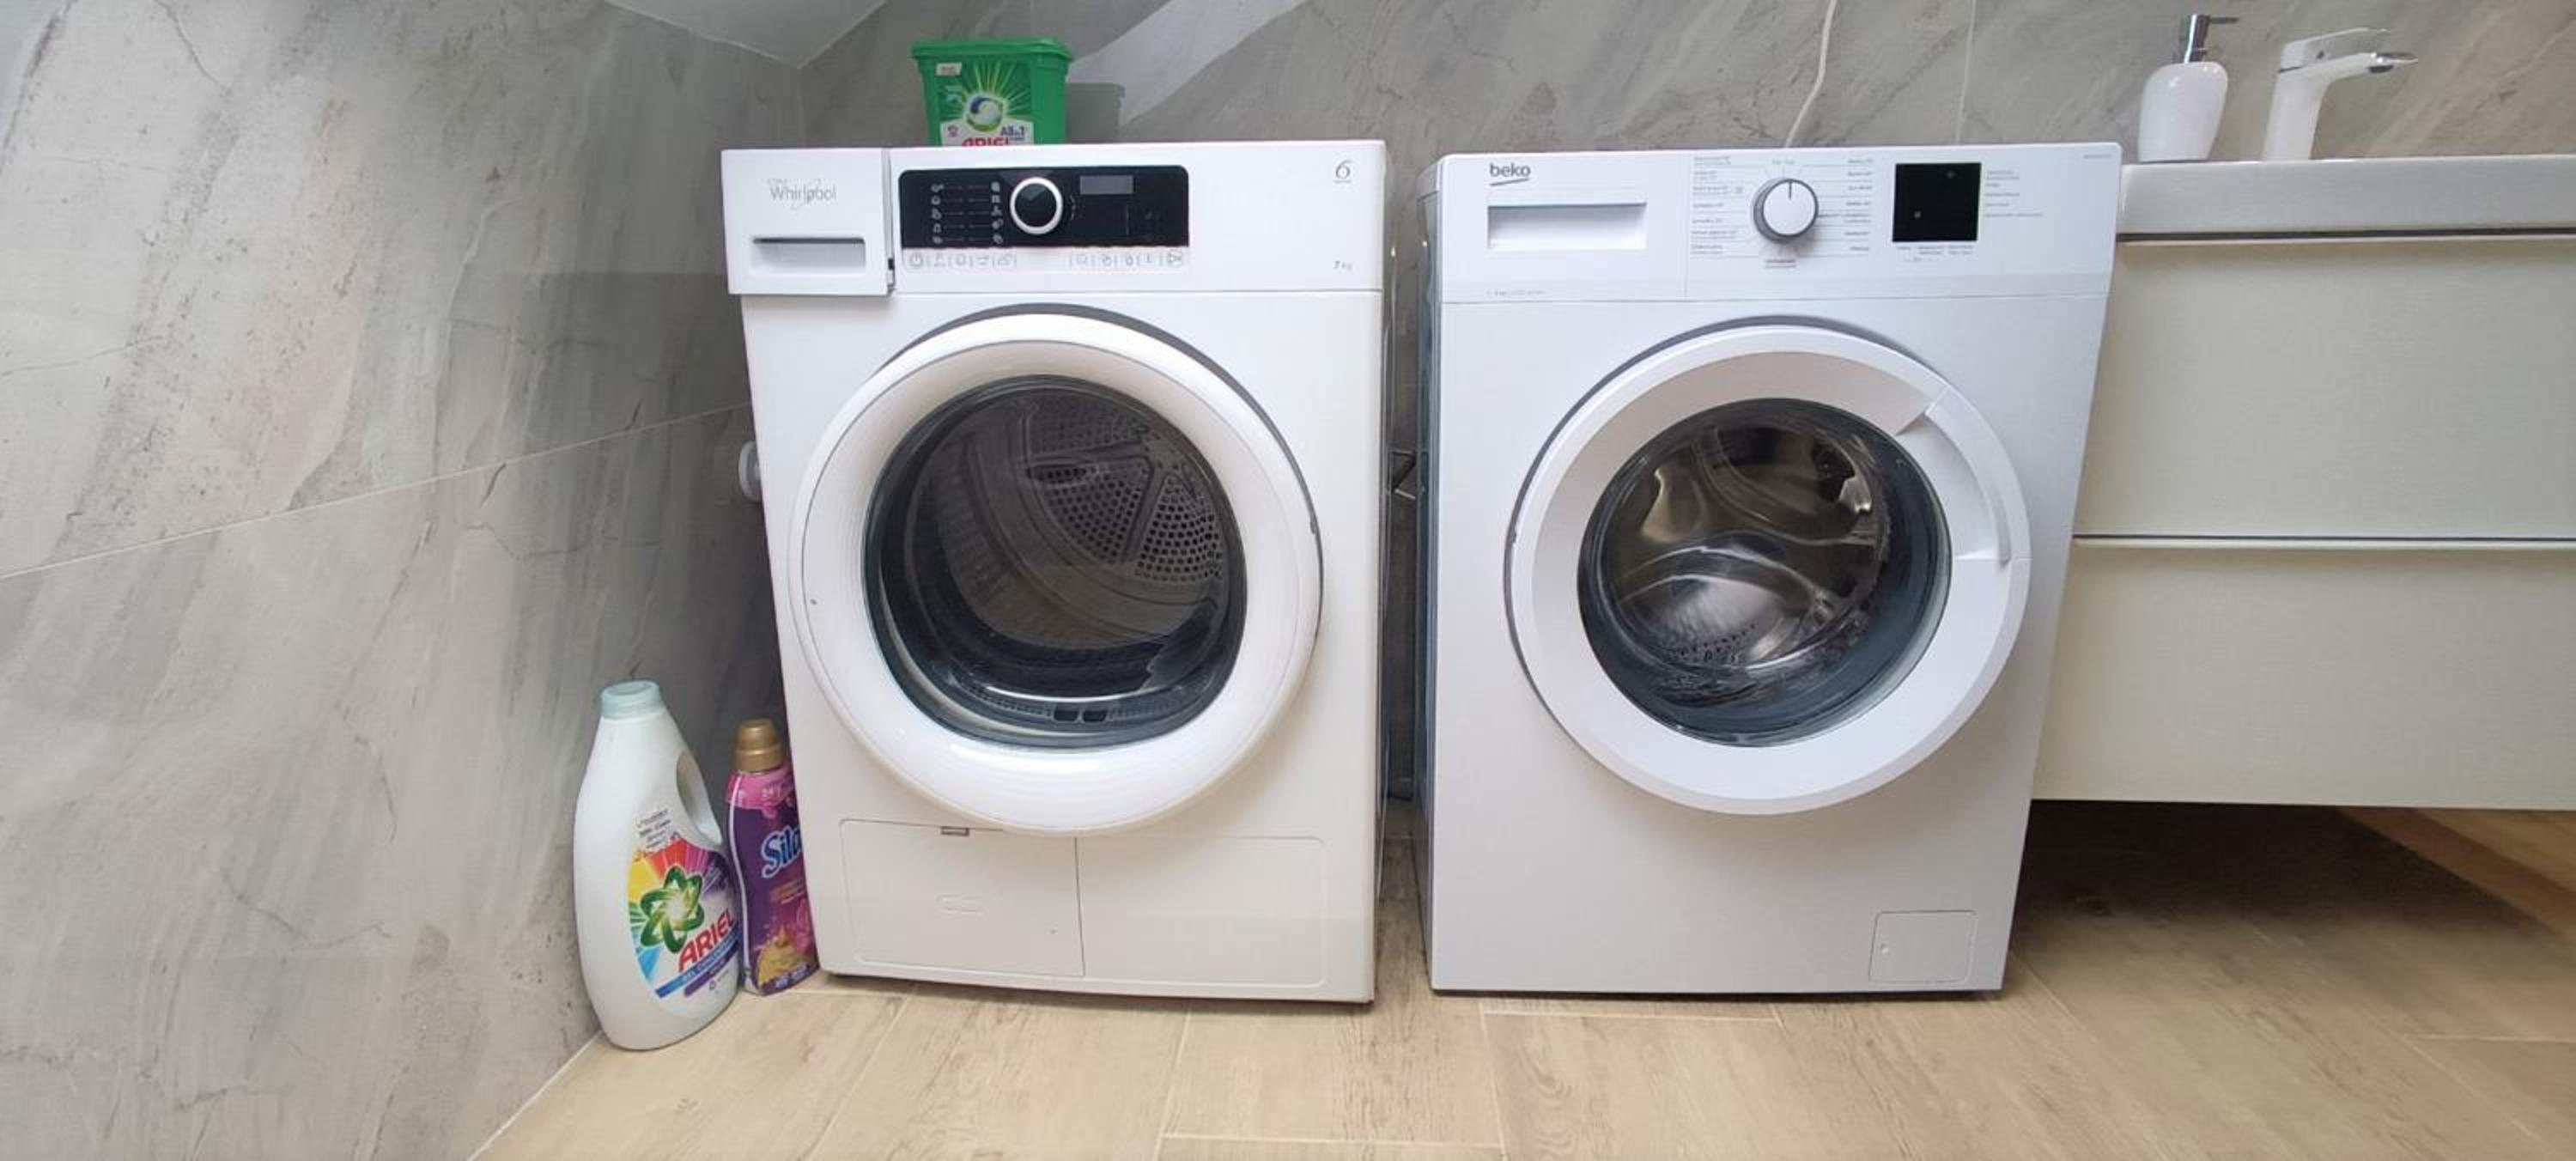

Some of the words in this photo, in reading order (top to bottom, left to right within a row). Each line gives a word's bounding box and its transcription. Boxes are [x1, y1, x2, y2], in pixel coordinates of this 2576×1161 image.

[1489, 161, 1531, 178] beko
[769, 185, 837, 204] Whirlpool
[678, 909, 734, 973] ARIEL
